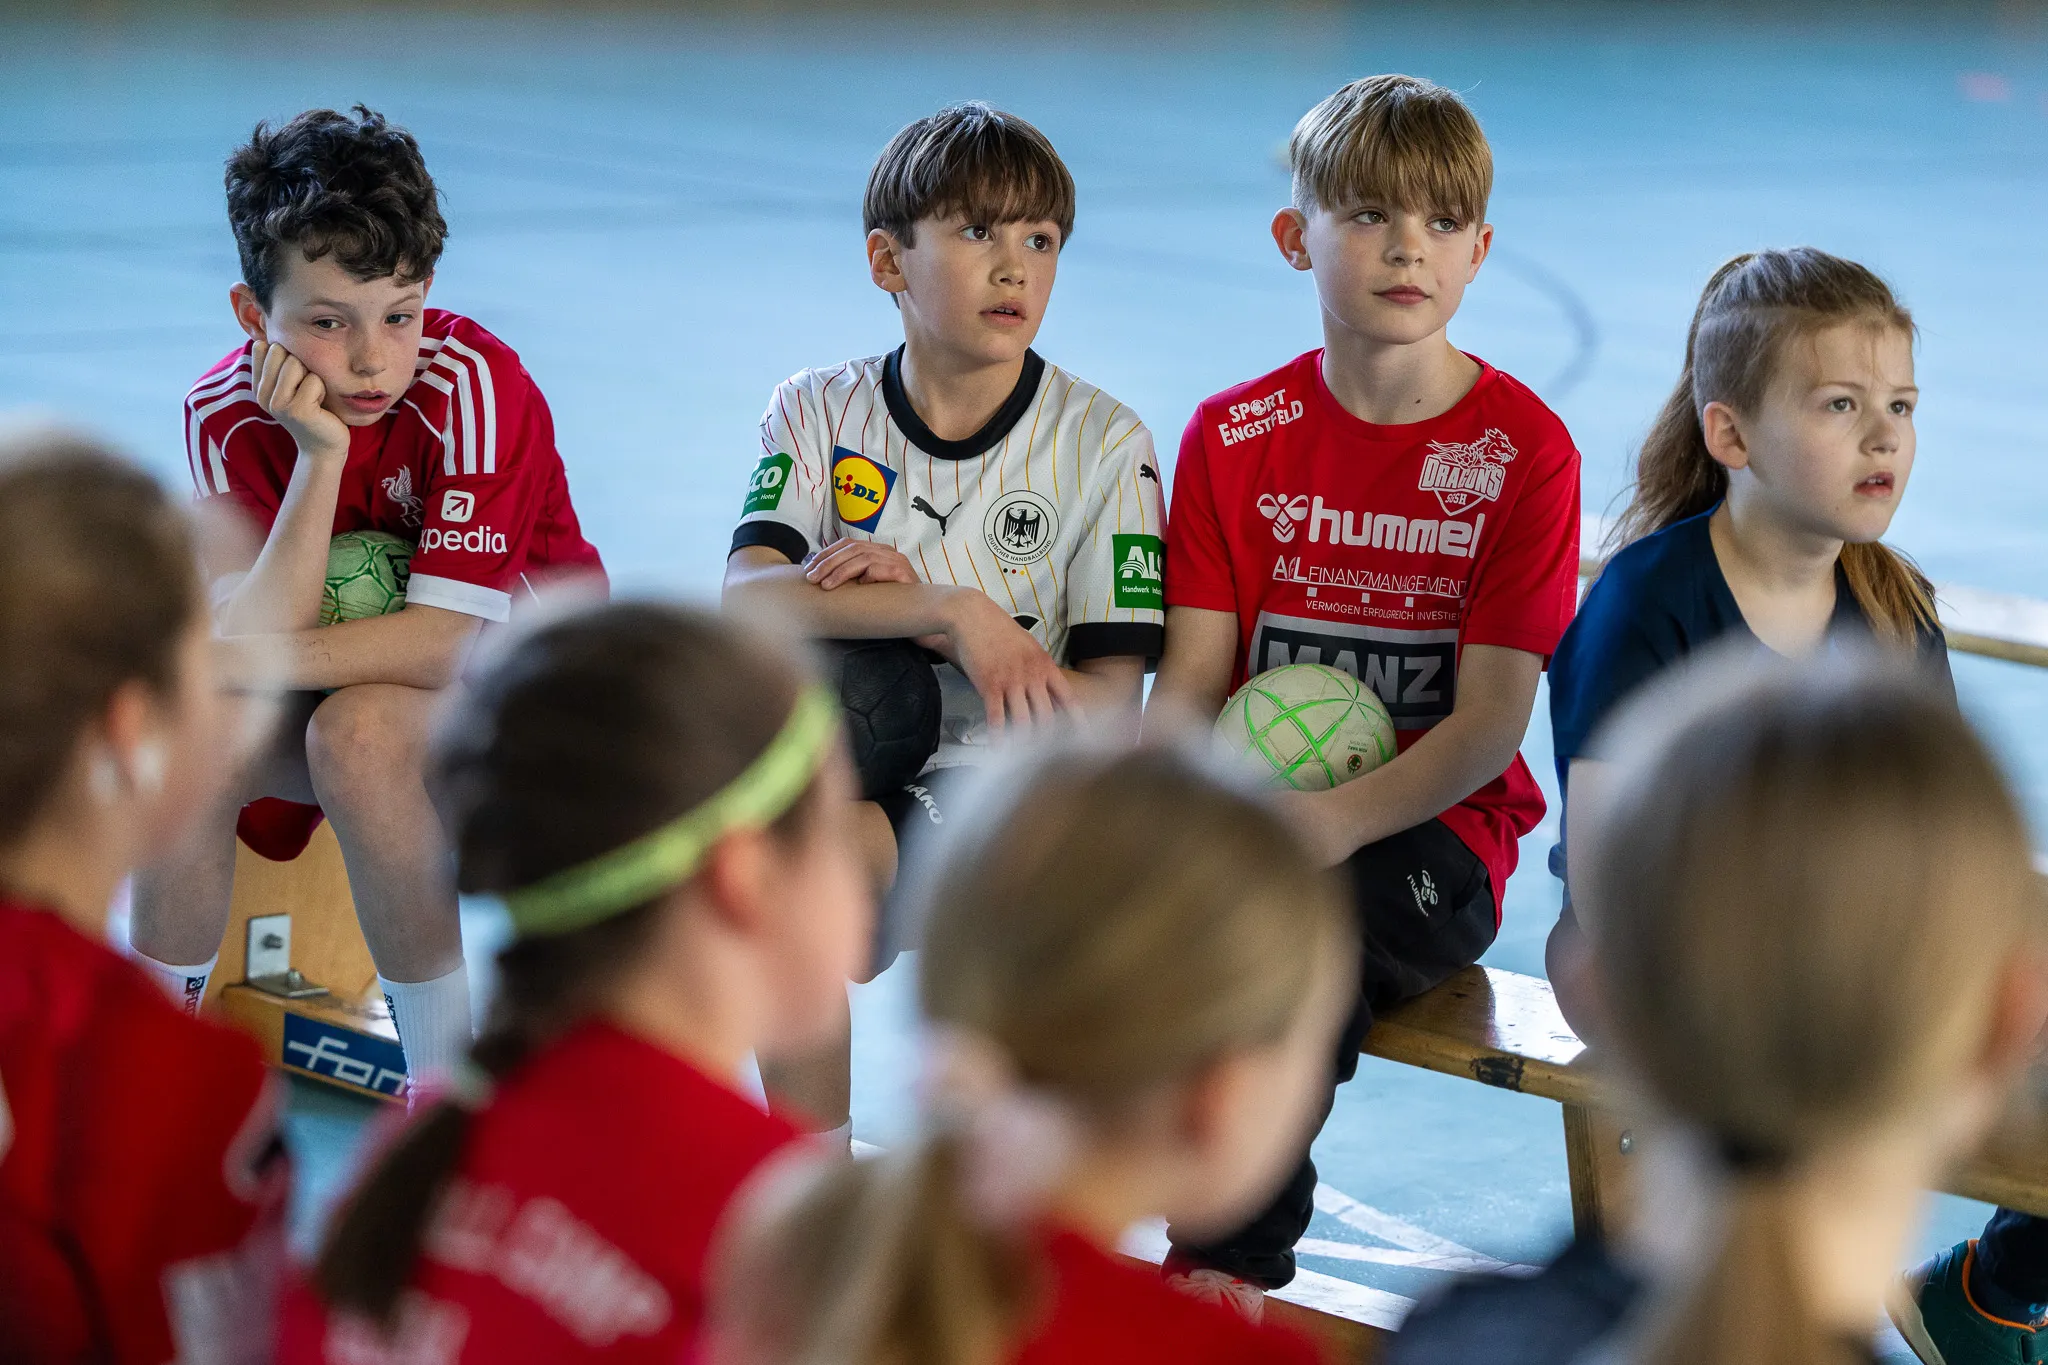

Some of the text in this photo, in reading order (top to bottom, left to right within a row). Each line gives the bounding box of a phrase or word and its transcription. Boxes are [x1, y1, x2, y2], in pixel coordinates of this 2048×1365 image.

[1229, 388, 1286, 423] SPORT
[1218, 400, 1304, 447] ENGSTFELD
[750, 466, 783, 492] CO
[1421, 457, 1503, 499] DRAGONS
[1308, 495, 1486, 559] hummel
[987, 533, 1052, 562] DEUTSCHER HANDBALLBUND
[1305, 599, 1361, 615] VERMÖGEN
[1362, 606, 1414, 620] ERFOLGREICH
